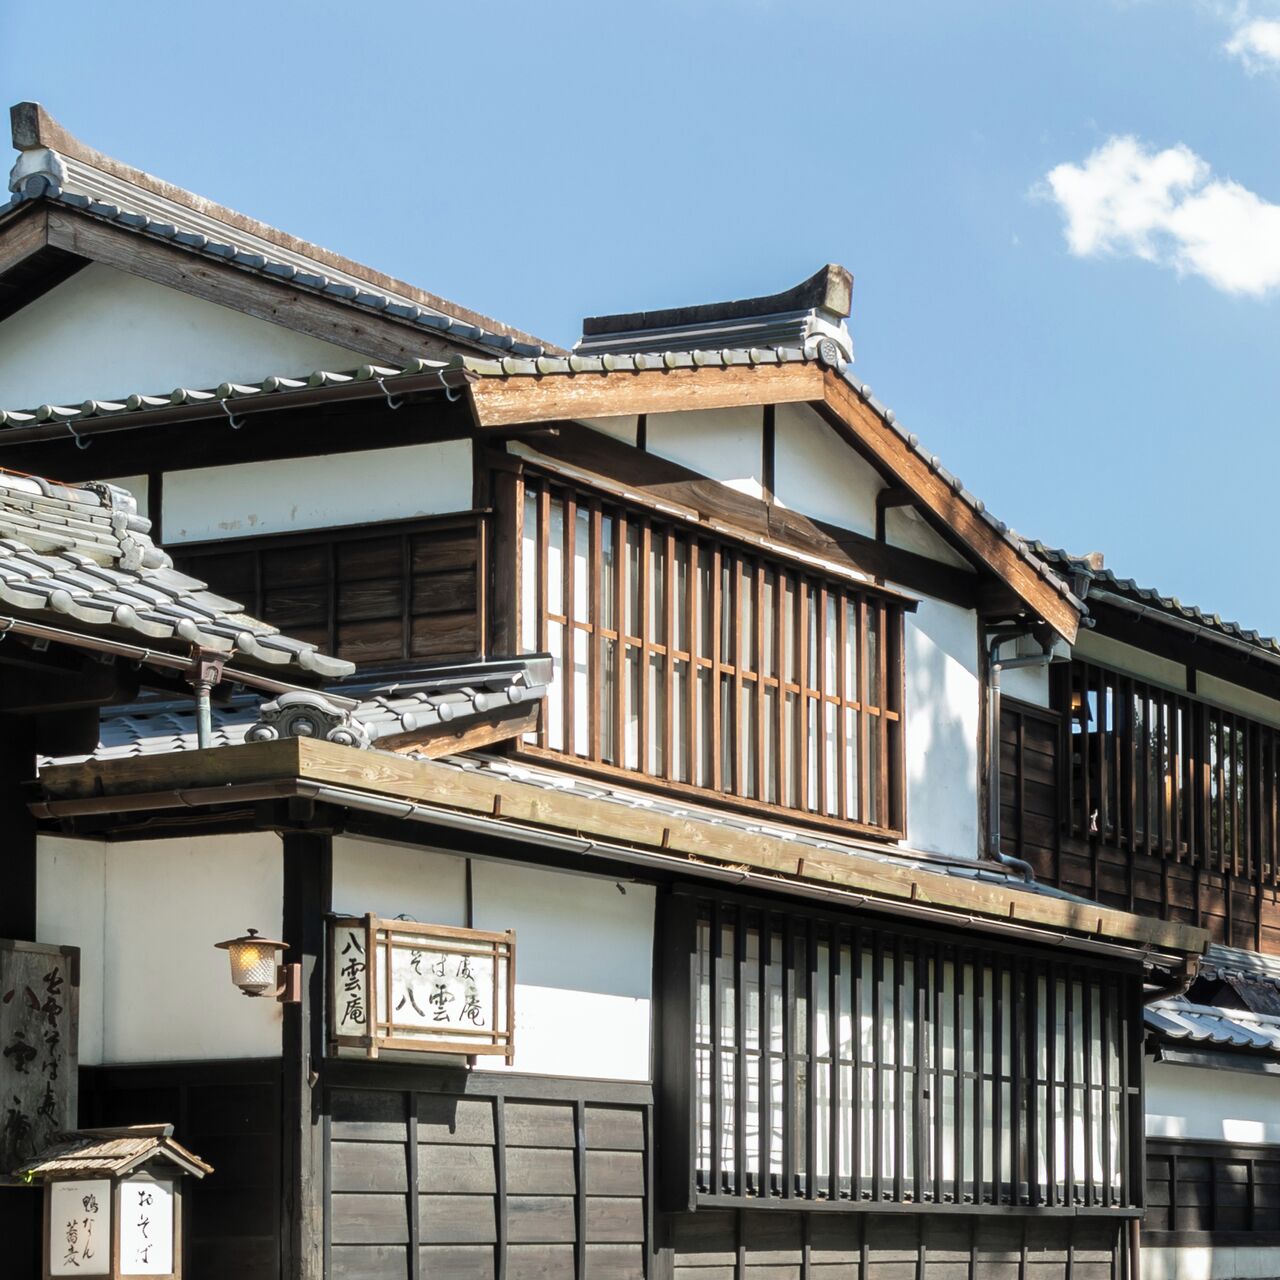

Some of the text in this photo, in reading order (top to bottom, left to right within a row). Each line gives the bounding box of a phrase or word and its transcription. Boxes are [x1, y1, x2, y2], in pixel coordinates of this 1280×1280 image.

[341, 931, 366, 1026] 八雲庵
[396, 983, 485, 1027] 八雲庵
[135, 1190, 154, 1264] おそば
